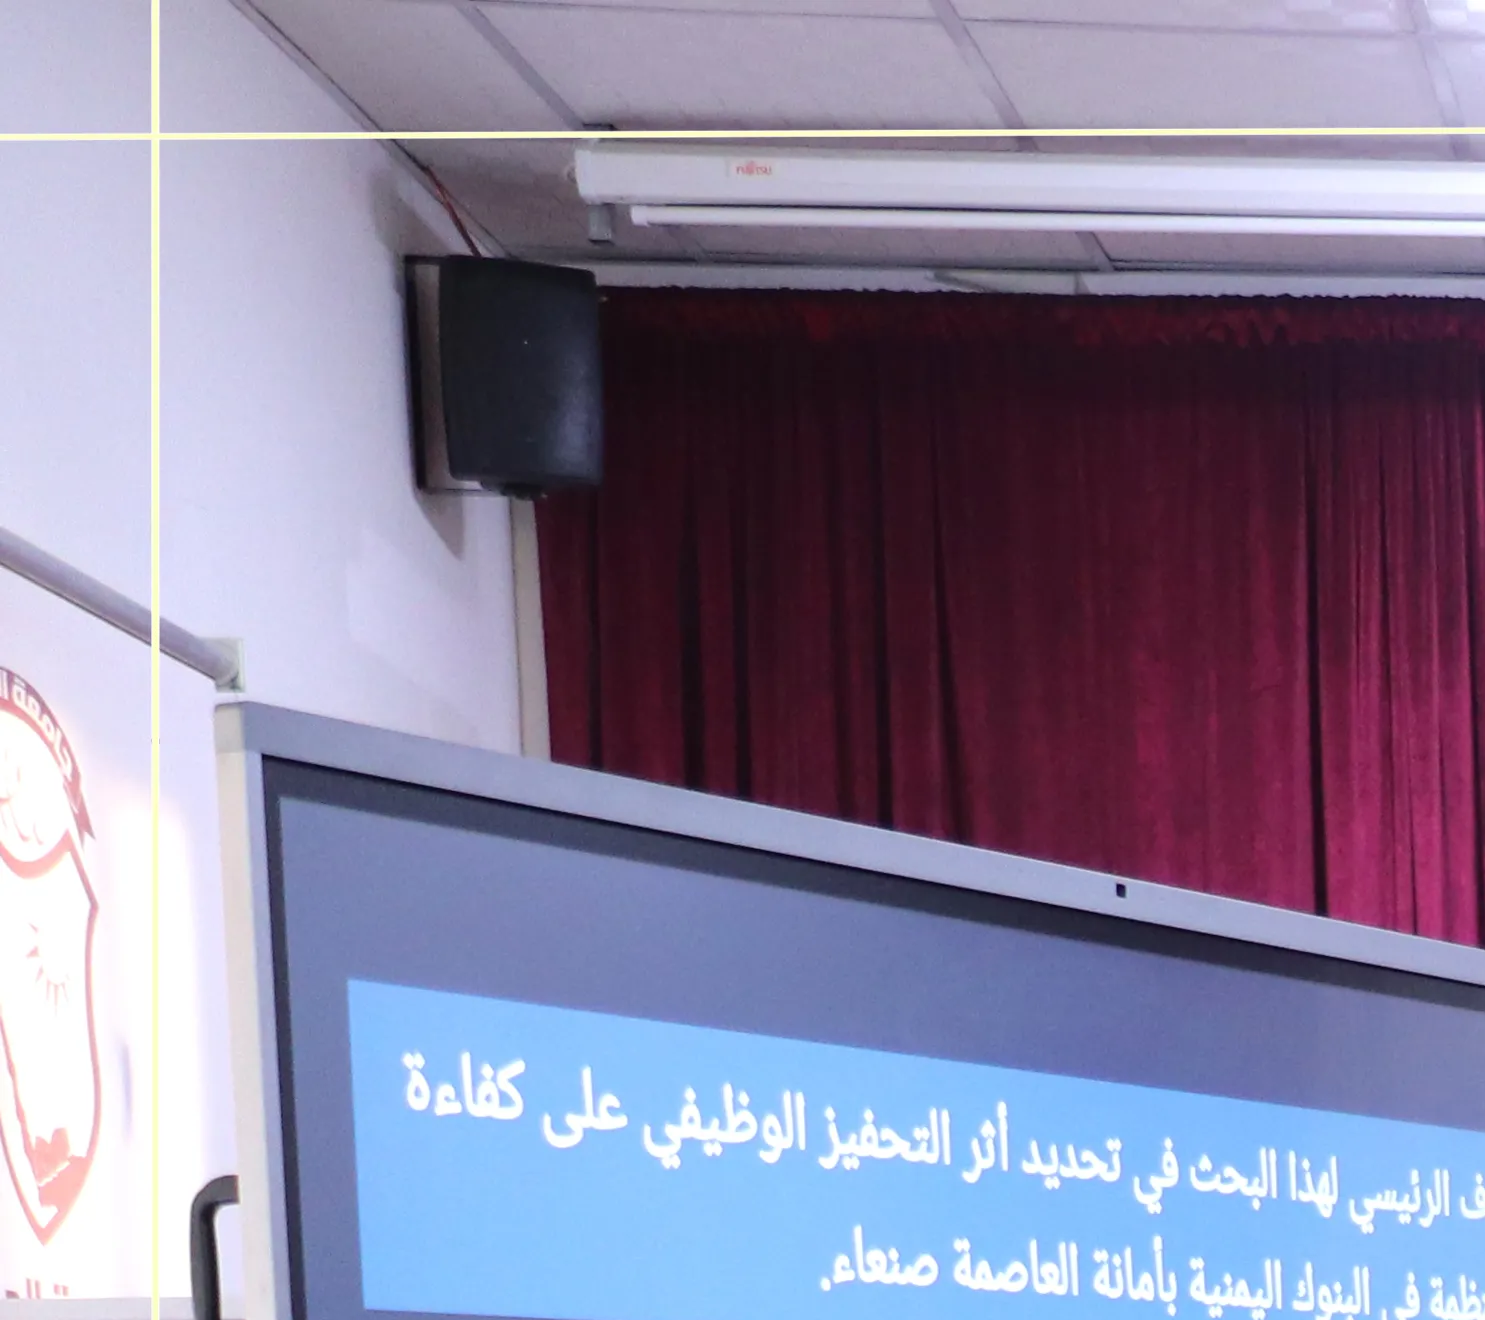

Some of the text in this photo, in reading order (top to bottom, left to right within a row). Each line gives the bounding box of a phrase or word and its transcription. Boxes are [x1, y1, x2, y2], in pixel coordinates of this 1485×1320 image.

[402, 1051, 525, 1120] كفاءة
[542, 1066, 628, 1149] على
[642, 1083, 806, 1169] الوظيفي
[818, 1106, 951, 1170] التحفيز
[961, 1101, 1009, 1183] أثر
[1021, 1138, 1122, 1190] تحديد
[1133, 1137, 1179, 1214] في
[1189, 1147, 1277, 1211] البحث
[1288, 1151, 1338, 1211] لهذا
[1348, 1169, 1450, 1234] الرئيسي
[820, 1225, 938, 1291] صنعاء.
[953, 1238, 1079, 1296] العاصمة
[1092, 1235, 1177, 1316] بأمانة
[1189, 1257, 1282, 1320] اليمنية
